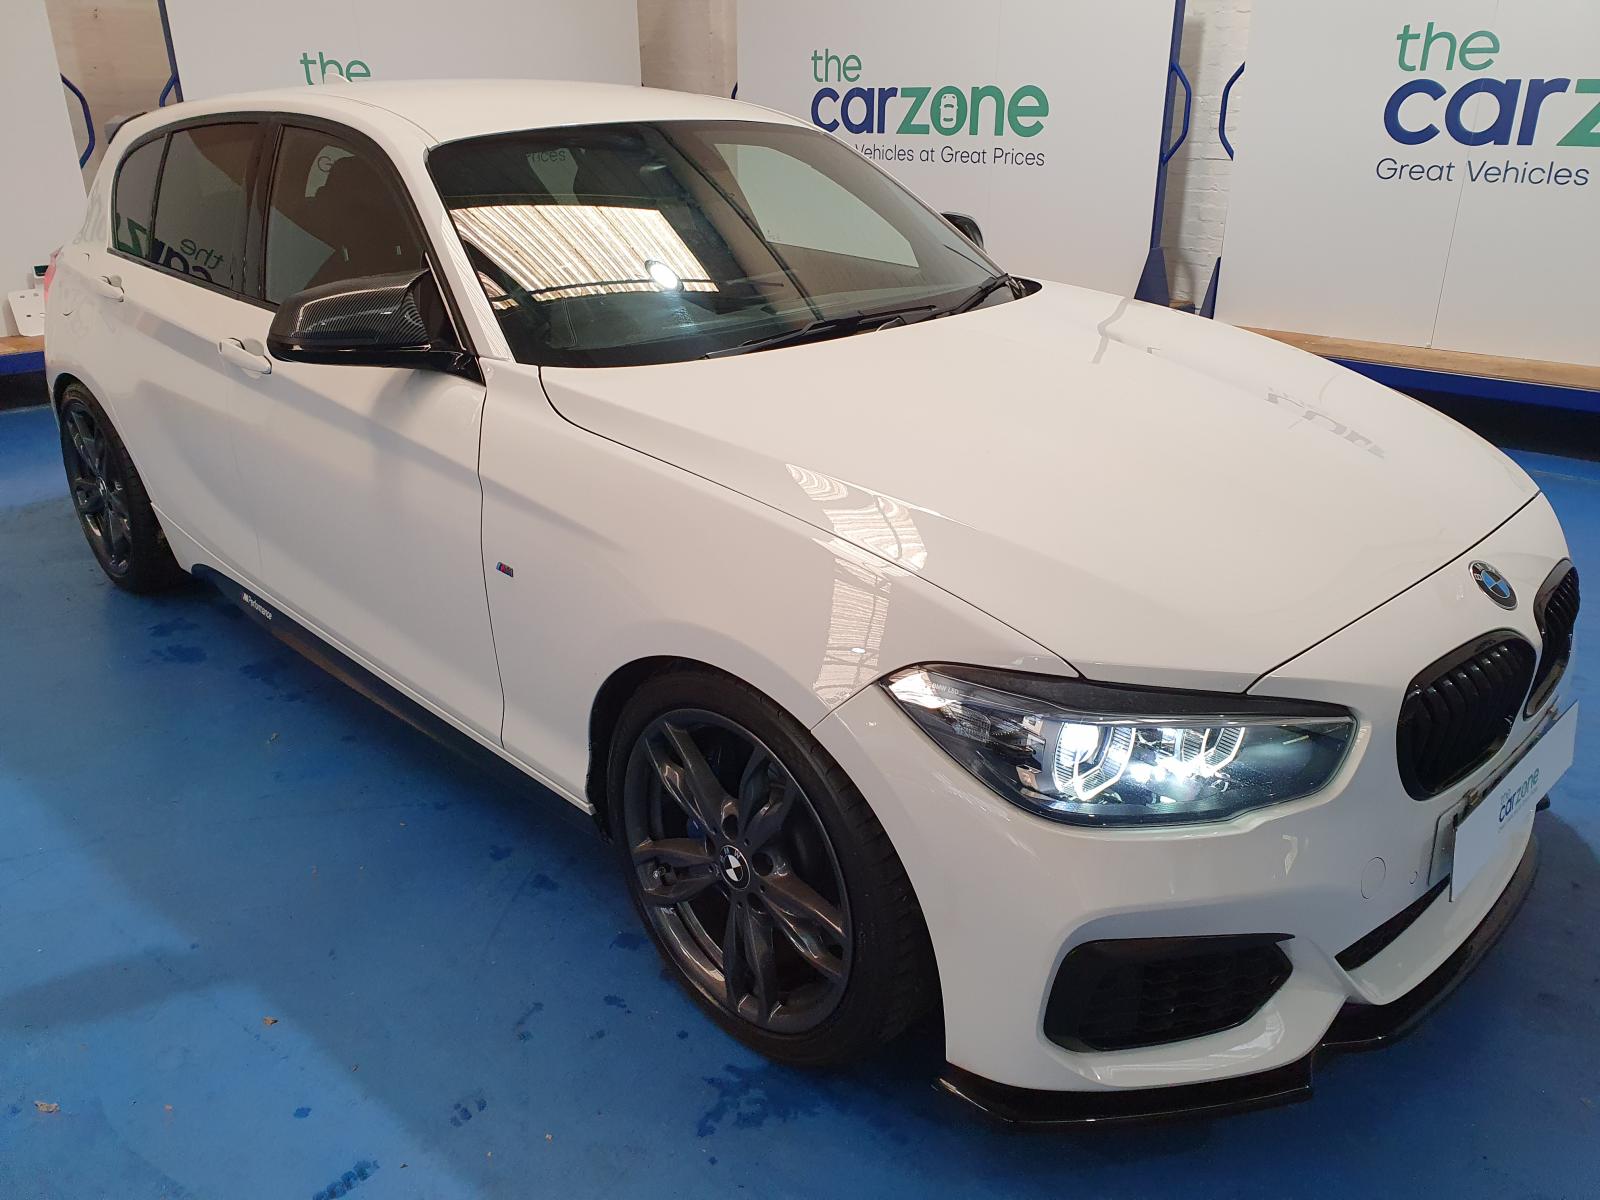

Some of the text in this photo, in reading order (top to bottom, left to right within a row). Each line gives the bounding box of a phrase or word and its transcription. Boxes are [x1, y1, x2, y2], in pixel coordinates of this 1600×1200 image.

[811, 48, 862, 83] the
[1396, 21, 1500, 72] the
[811, 84, 1050, 138] carzone
[919, 147, 935, 163] at
[941, 145, 987, 164] Great
[993, 147, 1045, 166] Prices
[1376, 157, 1590, 186] Great Vehicles
[1499, 768, 1540, 823] carzone
